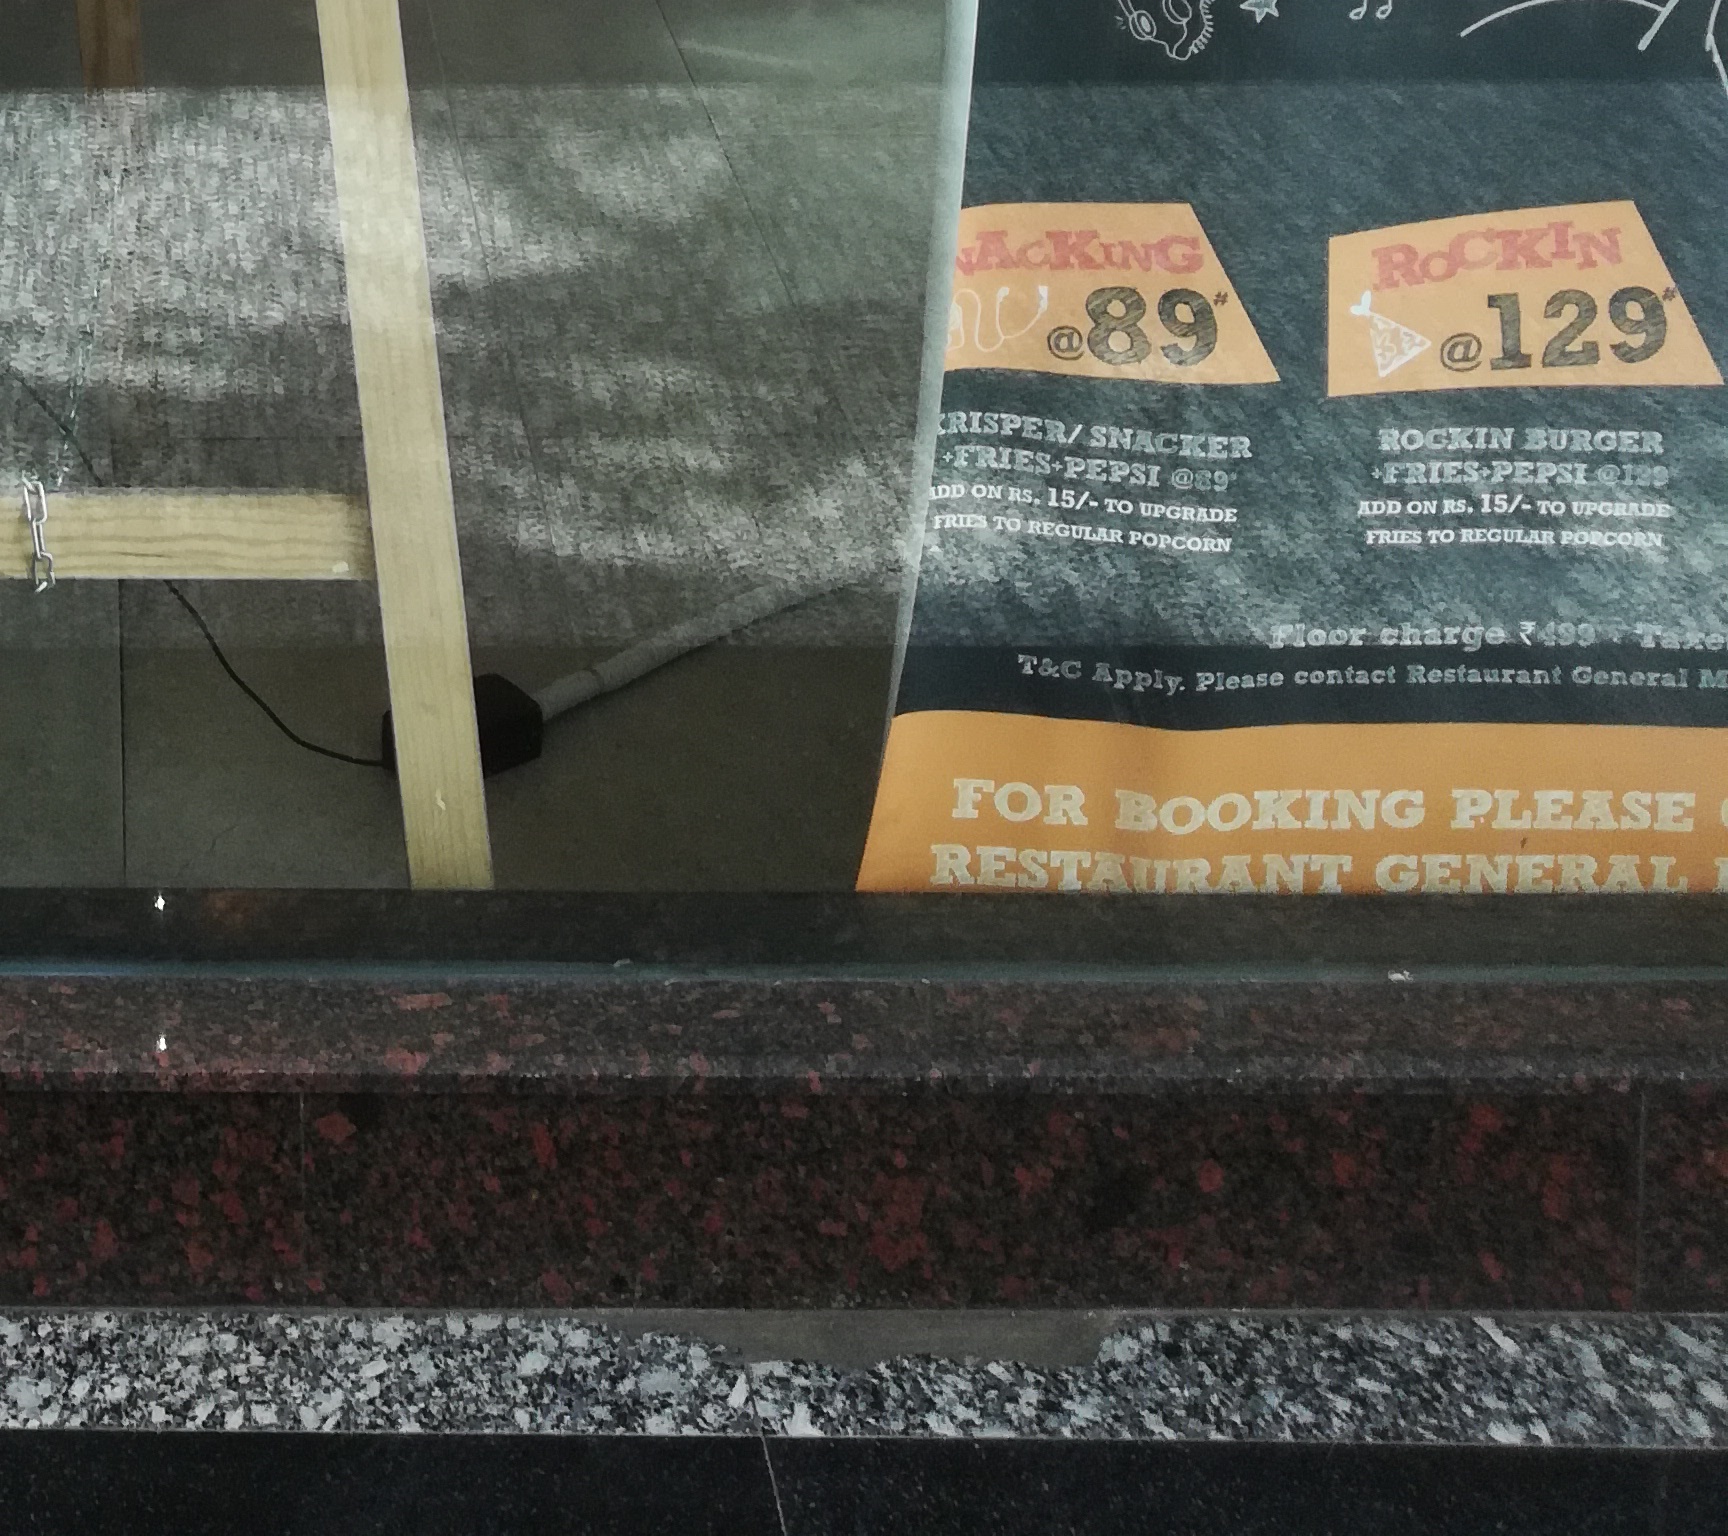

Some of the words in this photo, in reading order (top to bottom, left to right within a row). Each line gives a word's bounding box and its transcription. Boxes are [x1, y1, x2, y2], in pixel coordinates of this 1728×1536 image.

[1372, 221, 1622, 293] ROCKIN
[1090, 425, 1252, 459] SNACKER
[1378, 427, 1515, 451] ROCKIN
[1523, 428, 1663, 454] BURGER
[971, 485, 1005, 499] ON
[1009, 486, 1040, 504] RS.
[1048, 487, 1099, 510] 15/-
[1104, 497, 1133, 514] TO
[1140, 501, 1237, 523] UPGRADE
[1357, 500, 1402, 516] ADD
[1406, 500, 1437, 515] ON
[1442, 500, 1473, 514] RS.
[1480, 493, 1531, 514] 15/-
[1537, 501, 1565, 515] TO
[1571, 502, 1673, 518] UPGRADE
[933, 514, 987, 529] FRIES
[993, 516, 1021, 530] TO
[1027, 520, 1124, 543] REGULAR
[1128, 531, 1232, 552] POPCORN
[1366, 530, 1422, 544] FRIES
[1427, 529, 1455, 543] TO
[1461, 529, 1555, 544] REGULAR
[1561, 531, 1664, 548] POPCORN
[1379, 622, 1505, 652] charge
[1018, 653, 1080, 680] T&C
[1093, 662, 1187, 696] Apply.
[1195, 667, 1283, 692] Please
[1294, 665, 1396, 685] contact
[1406, 664, 1562, 685] Restaurant
[1572, 665, 1687, 687] General
[951, 777, 1087, 826] FOR
[1114, 786, 1424, 835] BOOKING
[1450, 787, 1695, 832] PLEASE
[930, 842, 1353, 895] RESTAURANT
[1375, 853, 1689, 895] GENERAL
